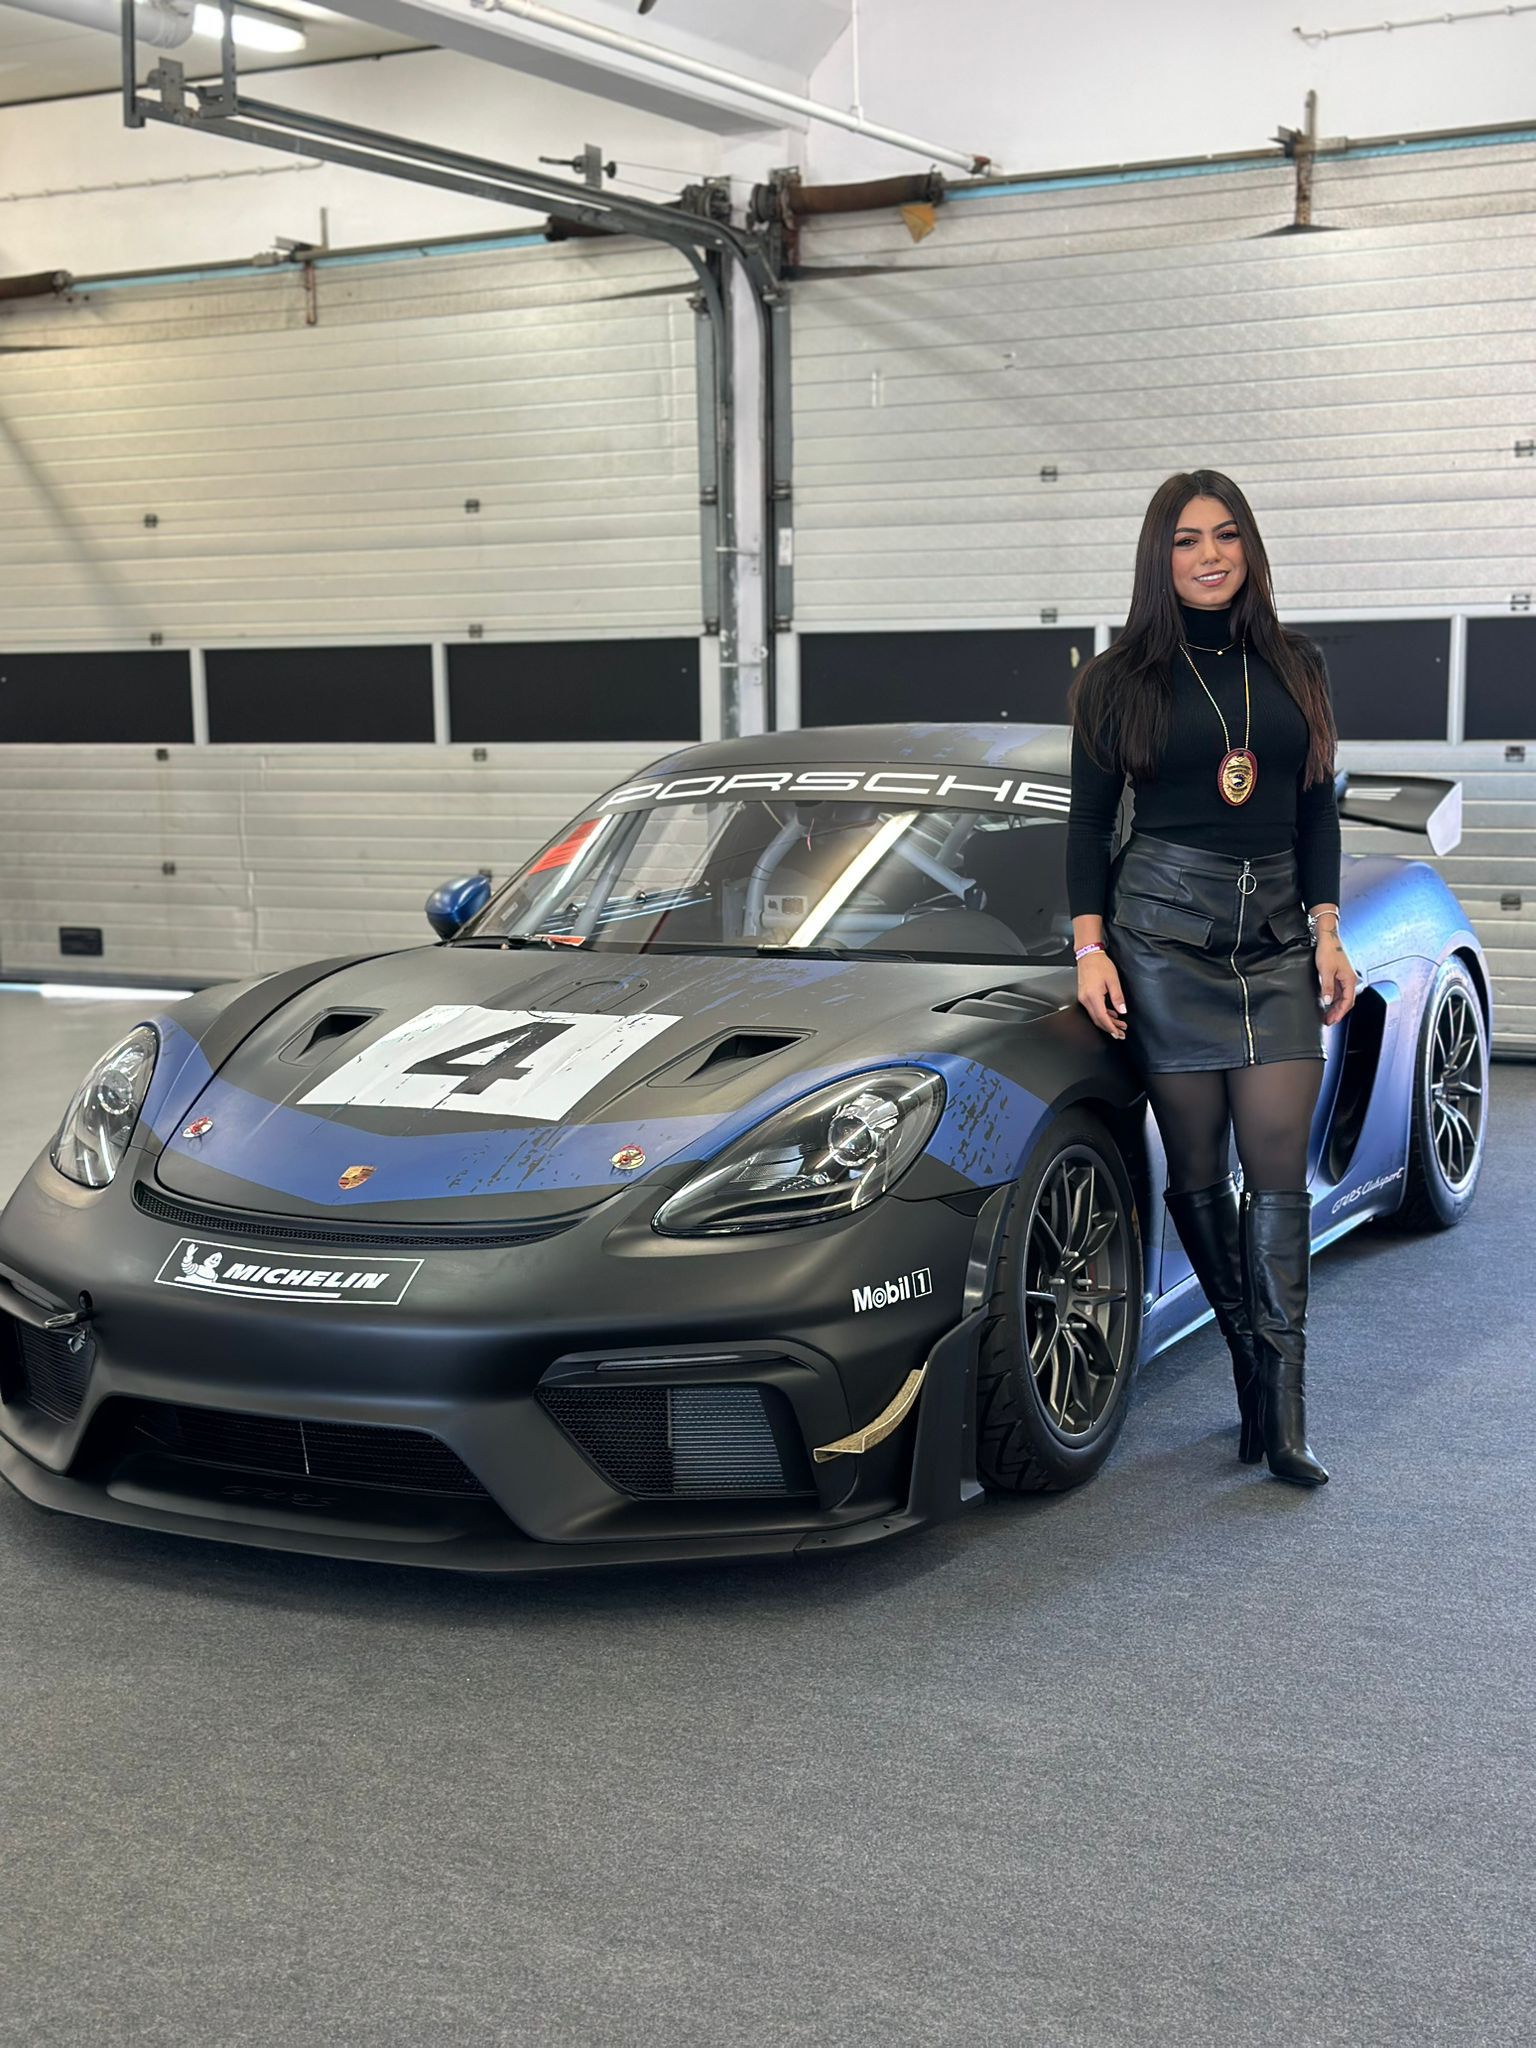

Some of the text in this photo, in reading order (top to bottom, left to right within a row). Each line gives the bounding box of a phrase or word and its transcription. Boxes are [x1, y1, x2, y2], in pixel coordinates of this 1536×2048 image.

[595, 771, 1072, 813] PORSCHE
[402, 1021, 577, 1095] 4
[222, 1262, 390, 1289] MICHELIN
[851, 1275, 911, 1313] Mobil
